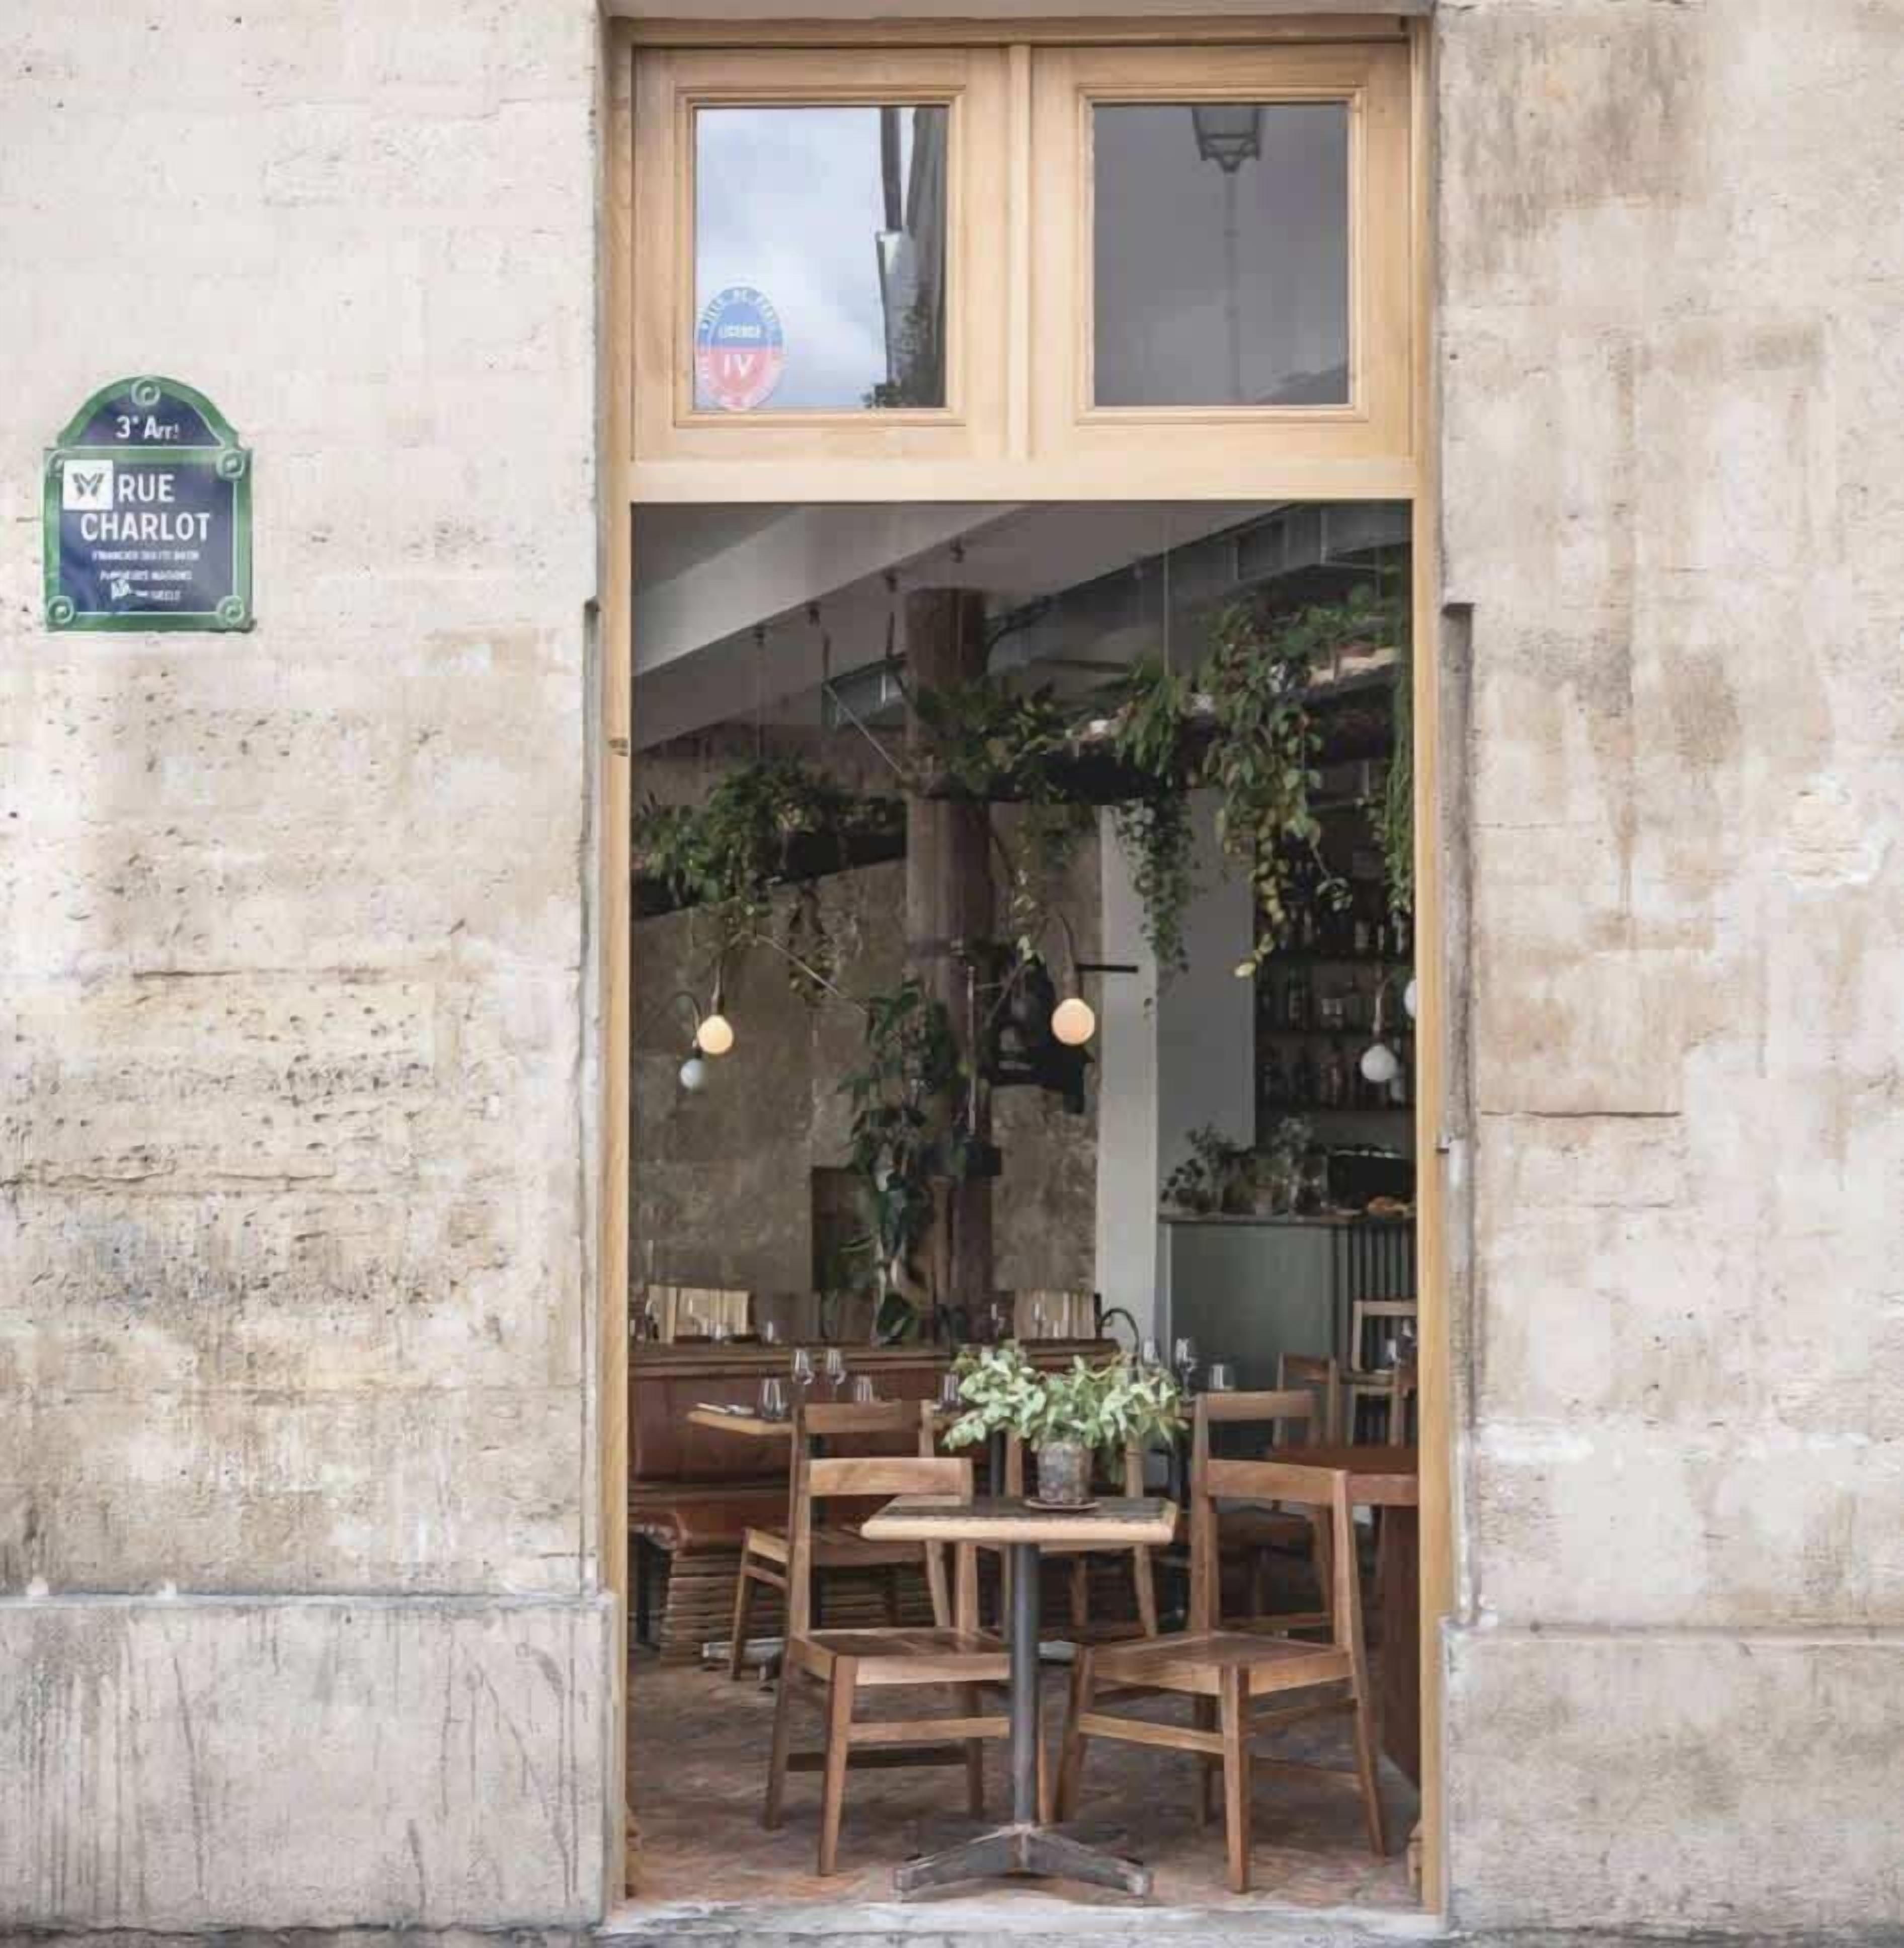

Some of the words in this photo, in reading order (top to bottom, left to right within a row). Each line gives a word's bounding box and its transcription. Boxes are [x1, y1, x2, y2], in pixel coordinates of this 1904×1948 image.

[723, 353, 755, 379] IV
[118, 473, 176, 503] RUE
[80, 512, 211, 541] CHARLOT
